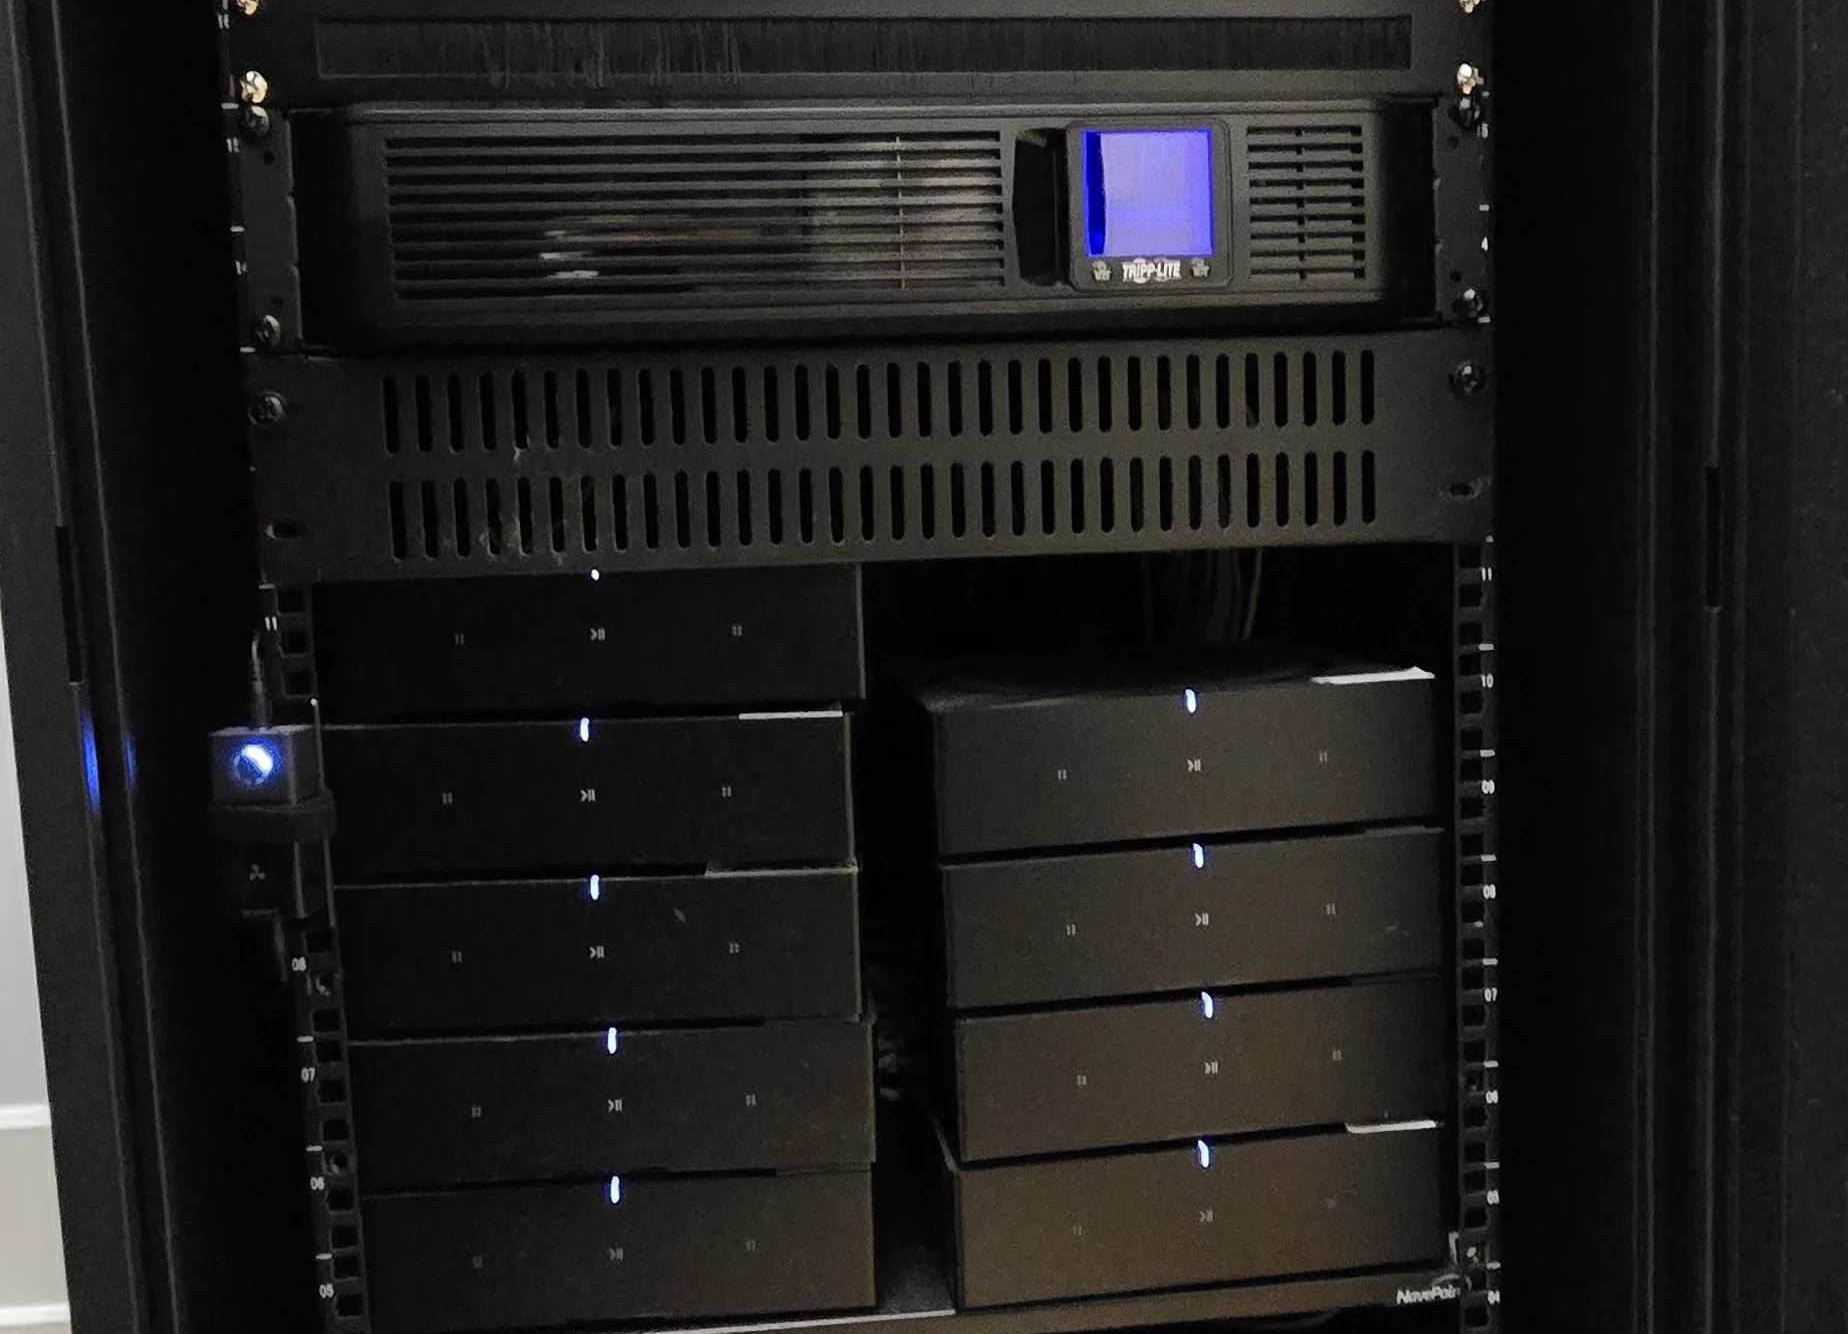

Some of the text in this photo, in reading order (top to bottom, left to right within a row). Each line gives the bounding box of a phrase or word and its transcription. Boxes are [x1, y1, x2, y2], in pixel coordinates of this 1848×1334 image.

[1484, 987, 1498, 1002] 07
[301, 1067, 316, 1083] 07
[318, 1283, 335, 1299] 05
